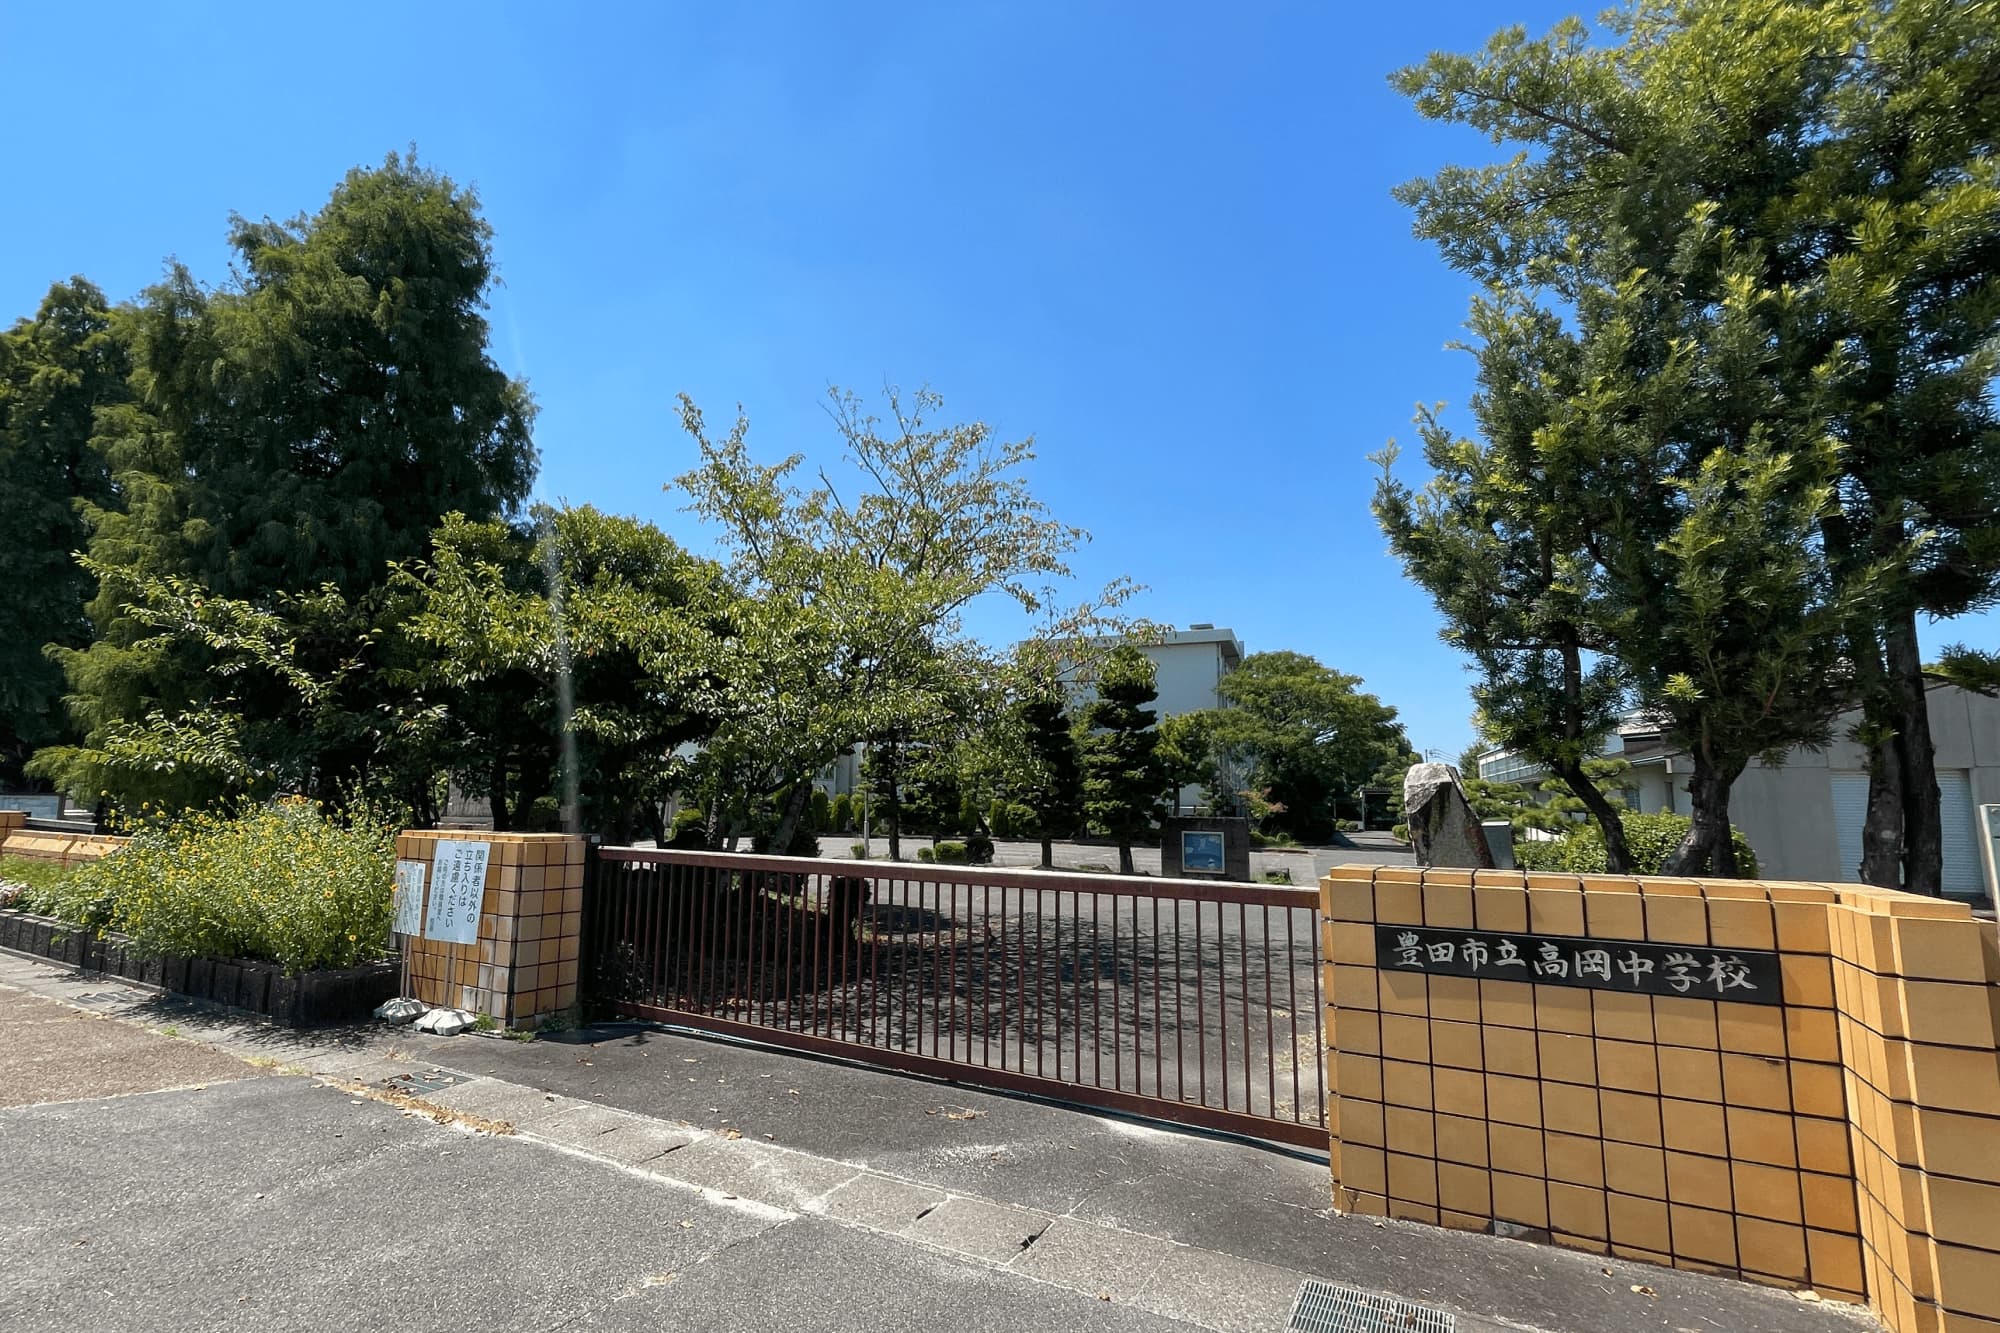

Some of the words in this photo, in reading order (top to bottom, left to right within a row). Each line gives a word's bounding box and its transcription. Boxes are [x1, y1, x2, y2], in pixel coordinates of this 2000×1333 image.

[446, 849, 462, 928] ご遠慮ください
[459, 850, 474, 907] 立ち入りは
[467, 850, 485, 924] 関係者以外の
[1393, 931, 1758, 993] 豊田市立高岡中学校
